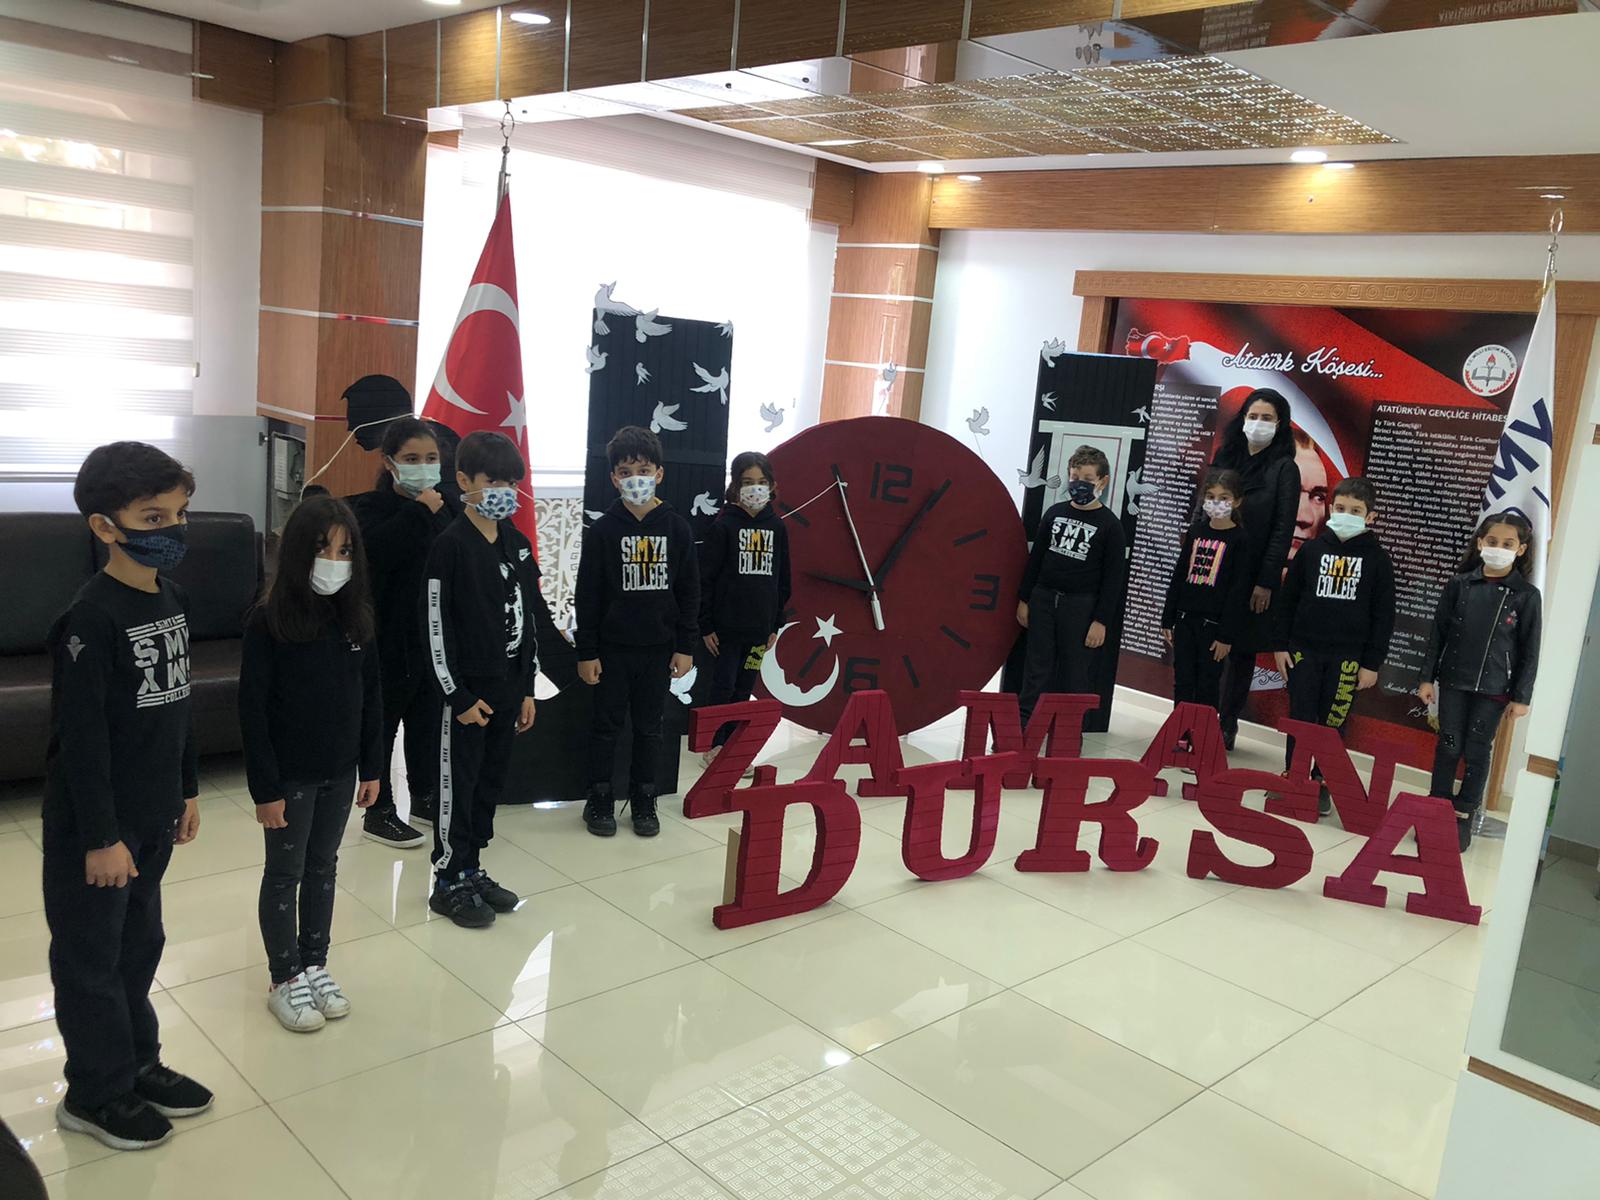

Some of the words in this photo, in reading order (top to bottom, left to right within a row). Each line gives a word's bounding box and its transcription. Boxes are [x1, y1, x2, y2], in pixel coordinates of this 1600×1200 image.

[1222, 342, 1295, 372] Atatürk
[1154, 384, 1165, 392] RŞI
[1376, 404, 1427, 416] ATATÜRK'ÜN
[1428, 408, 1470, 420] GENÇLİĞE
[1383, 419, 1396, 427] Türk
[870, 462, 912, 504] 12
[622, 562, 669, 591] COLLEGE
[1316, 575, 1360, 600] COLLEGE
[970, 574, 1000, 611] 3
[843, 656, 880, 693] 6
[683, 689, 1418, 838] ZAMAN
[712, 752, 1481, 927] DURSA
